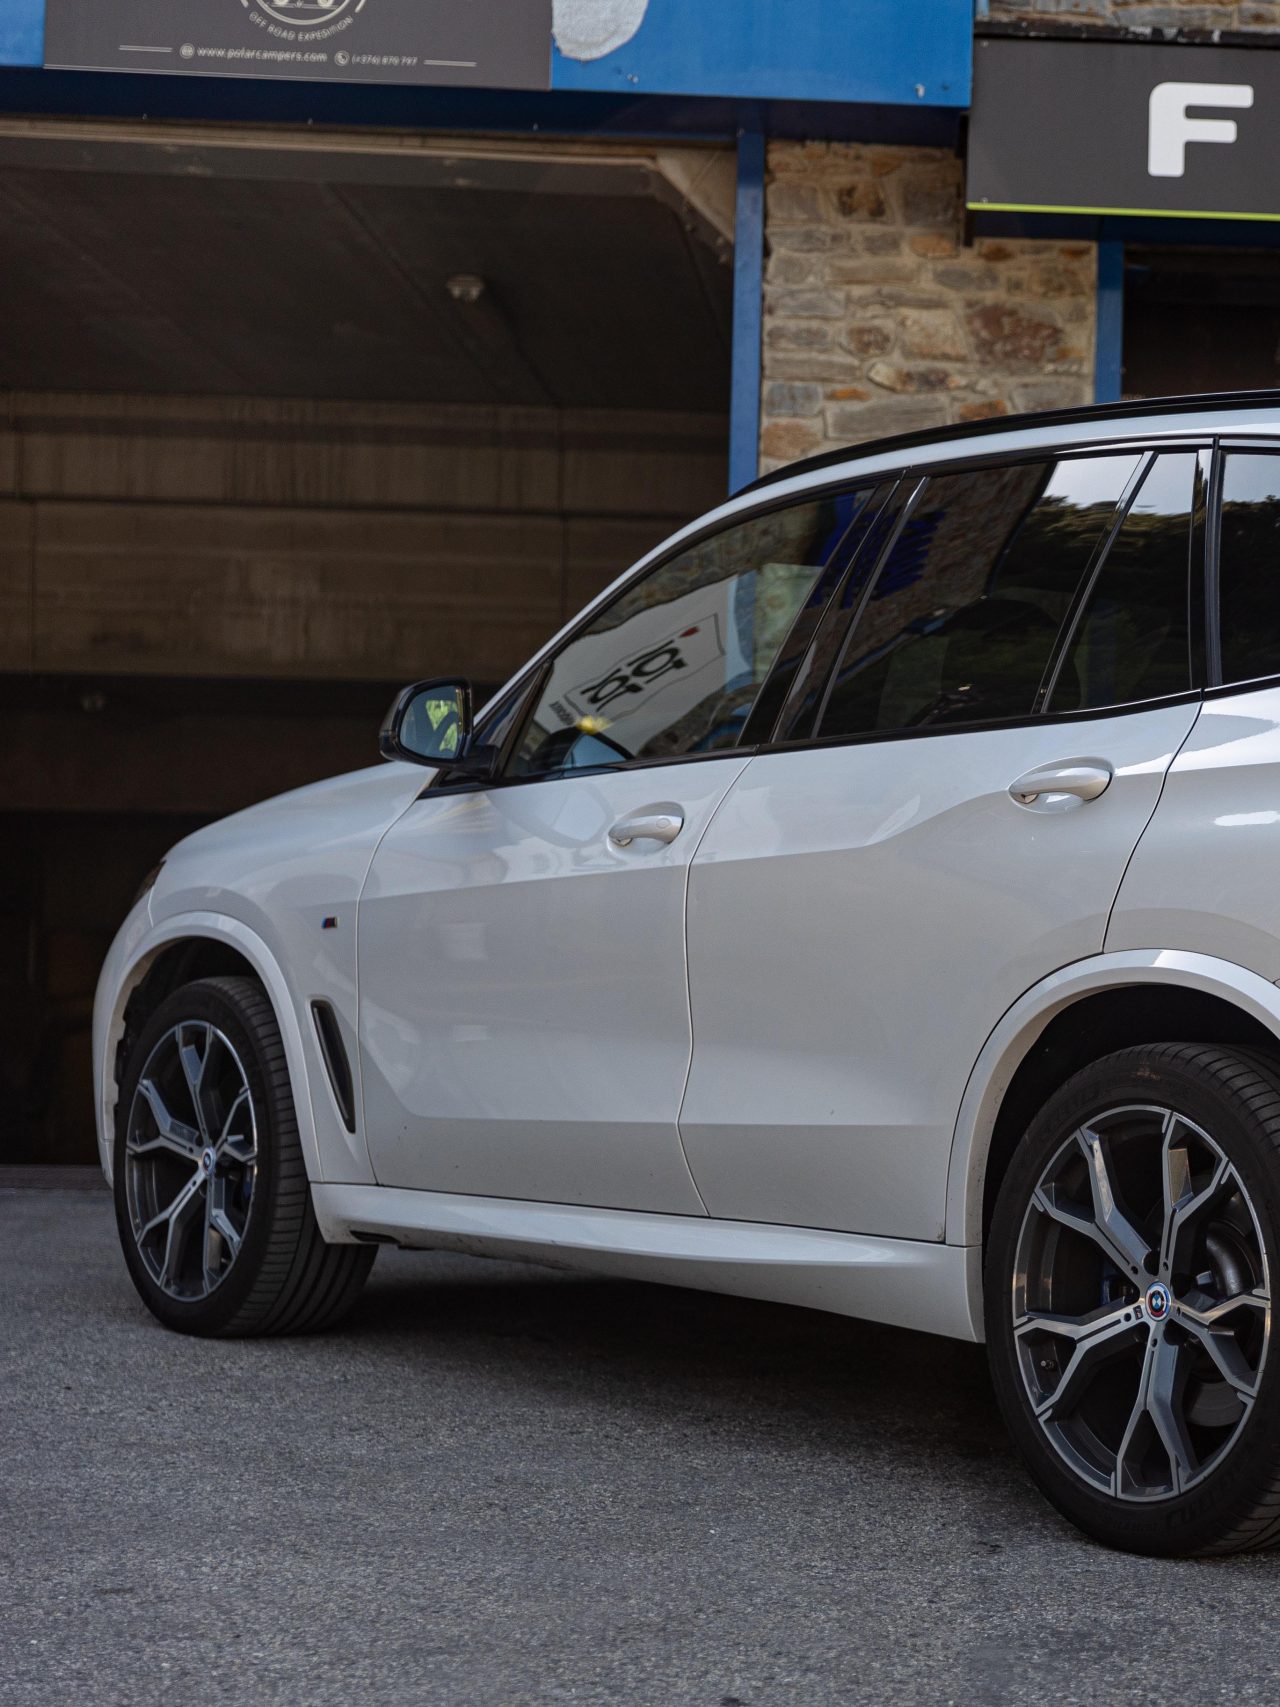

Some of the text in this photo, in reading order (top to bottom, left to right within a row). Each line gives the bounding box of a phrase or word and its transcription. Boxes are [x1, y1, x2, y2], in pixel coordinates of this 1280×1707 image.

[249, 11, 354, 42] OFF ROAD EXPEDITION
[197, 46, 328, 63] www.polarcampers.com
